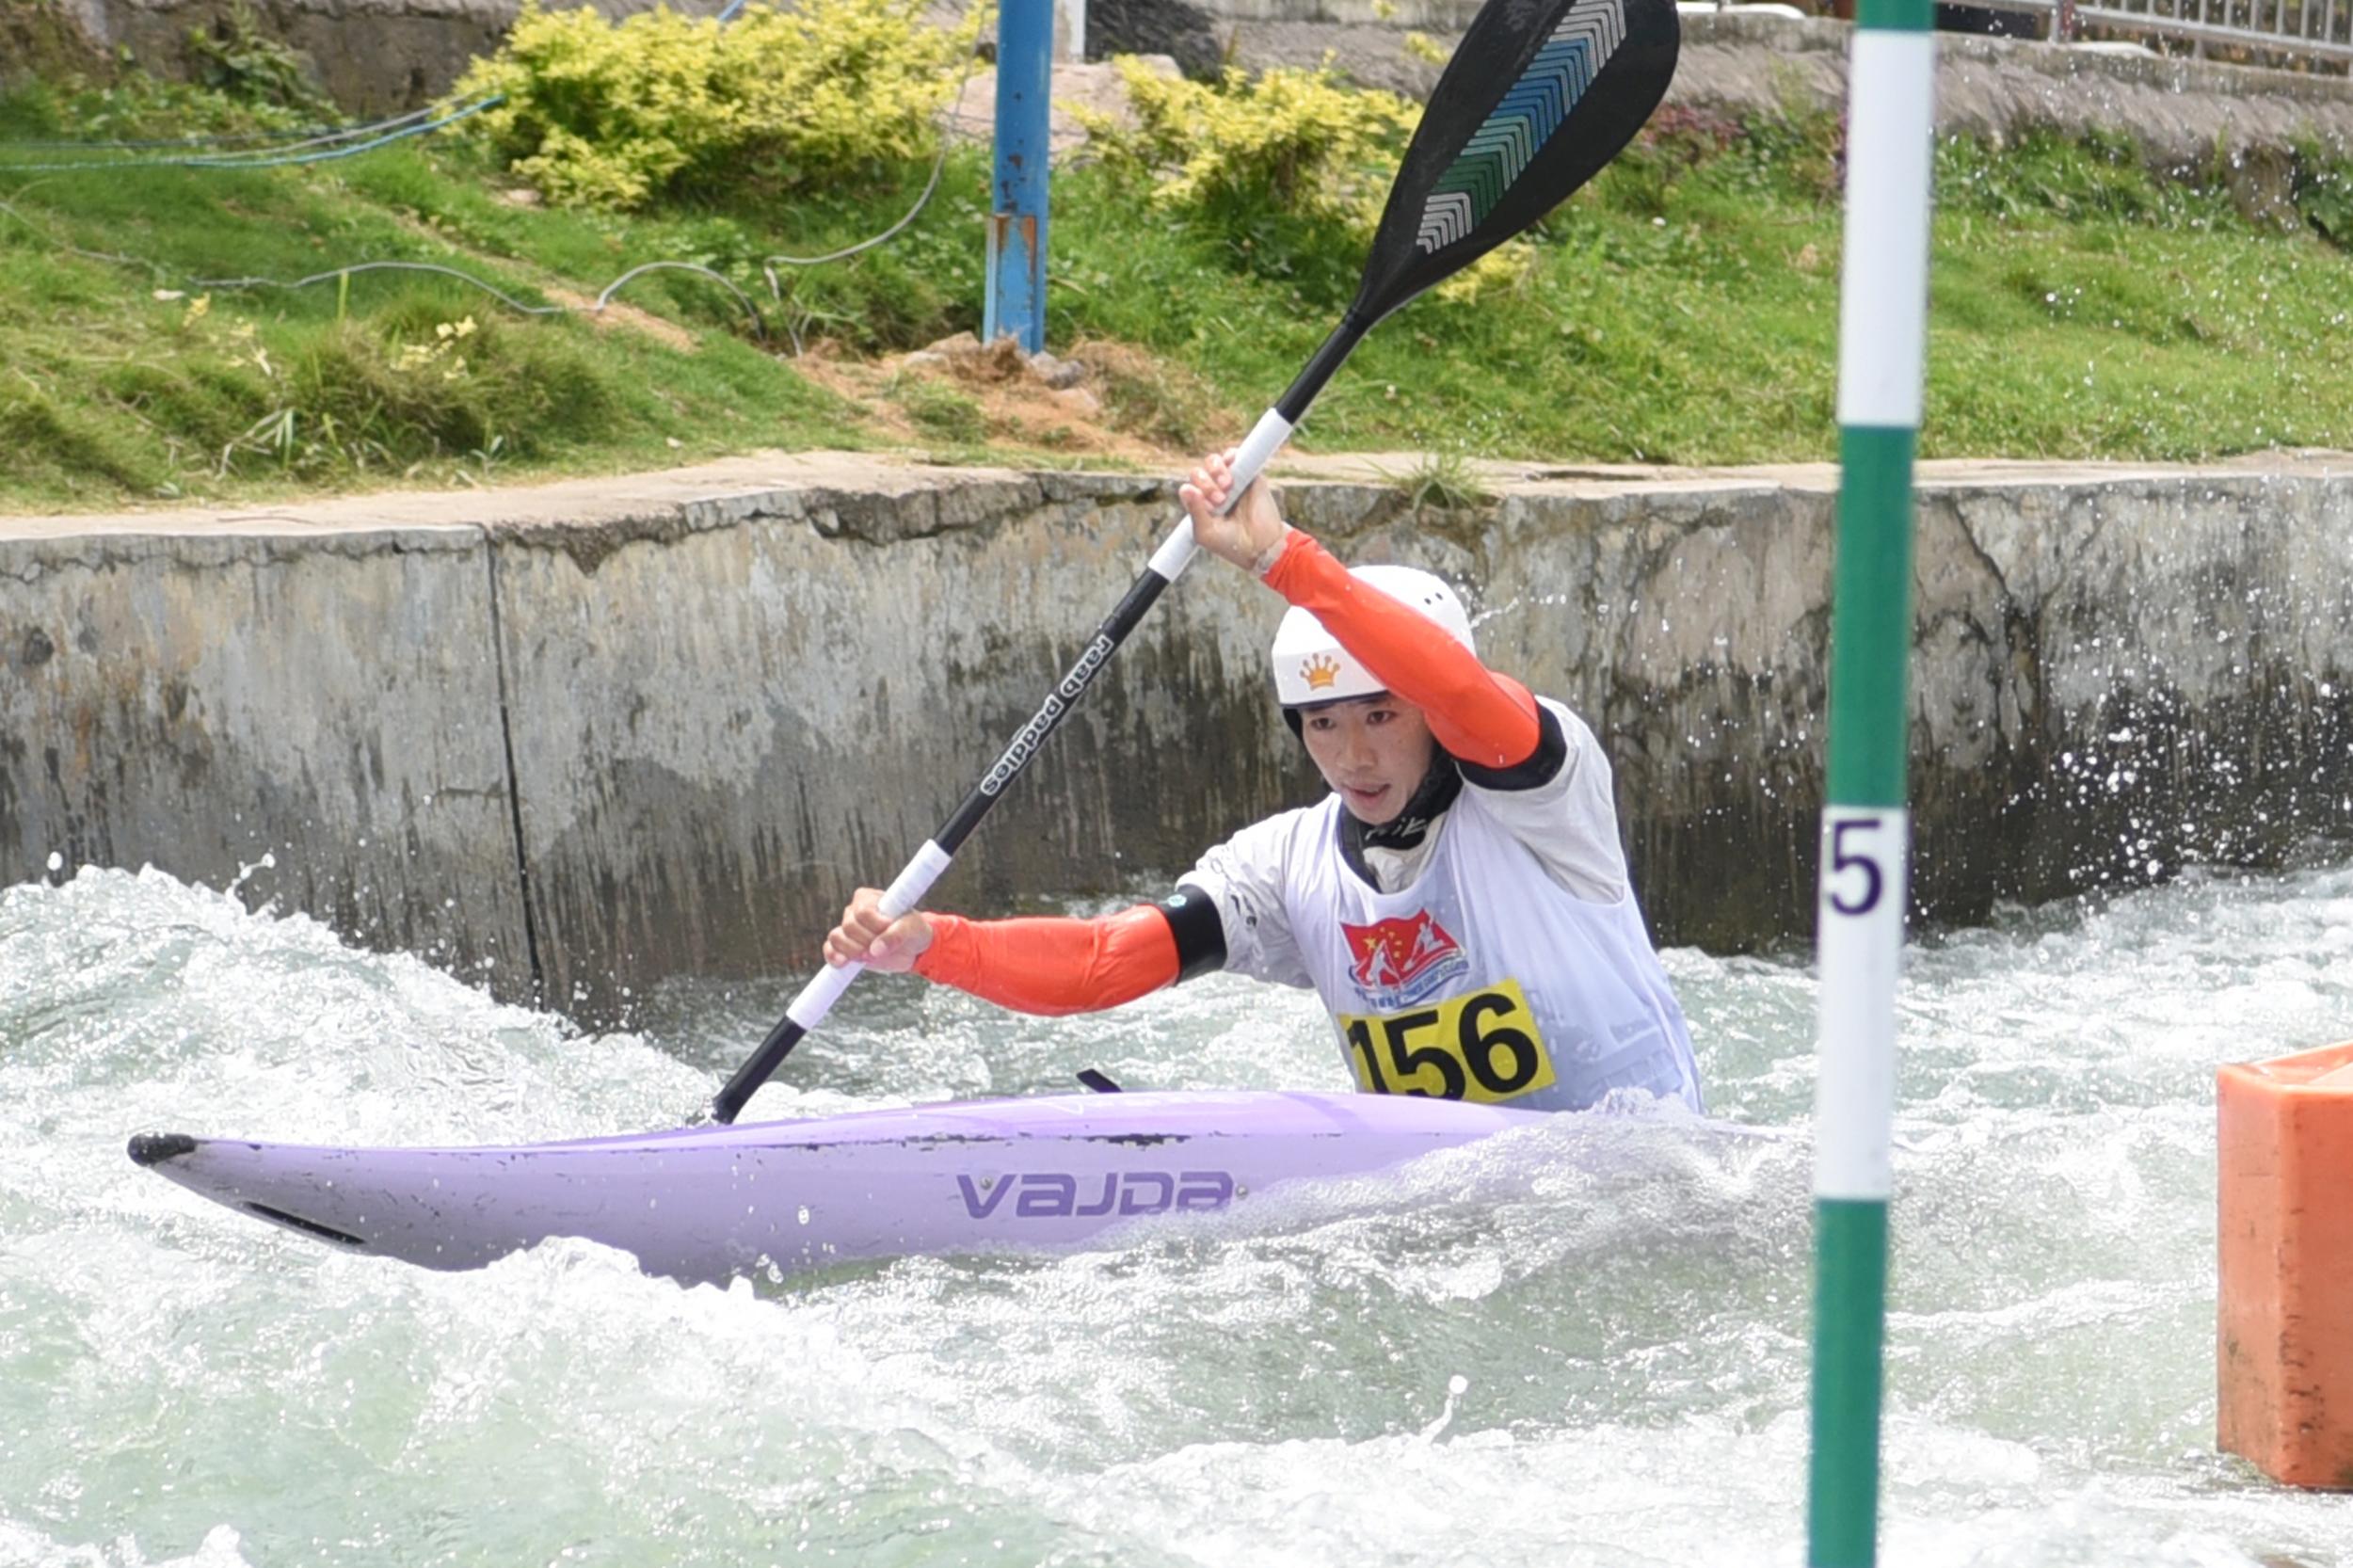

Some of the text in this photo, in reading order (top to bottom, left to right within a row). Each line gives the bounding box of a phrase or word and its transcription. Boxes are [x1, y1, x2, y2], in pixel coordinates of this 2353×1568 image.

[981, 634, 1114, 795] raab paddles
[1832, 819, 1882, 916] 5
[1346, 992, 1539, 1101] 156
